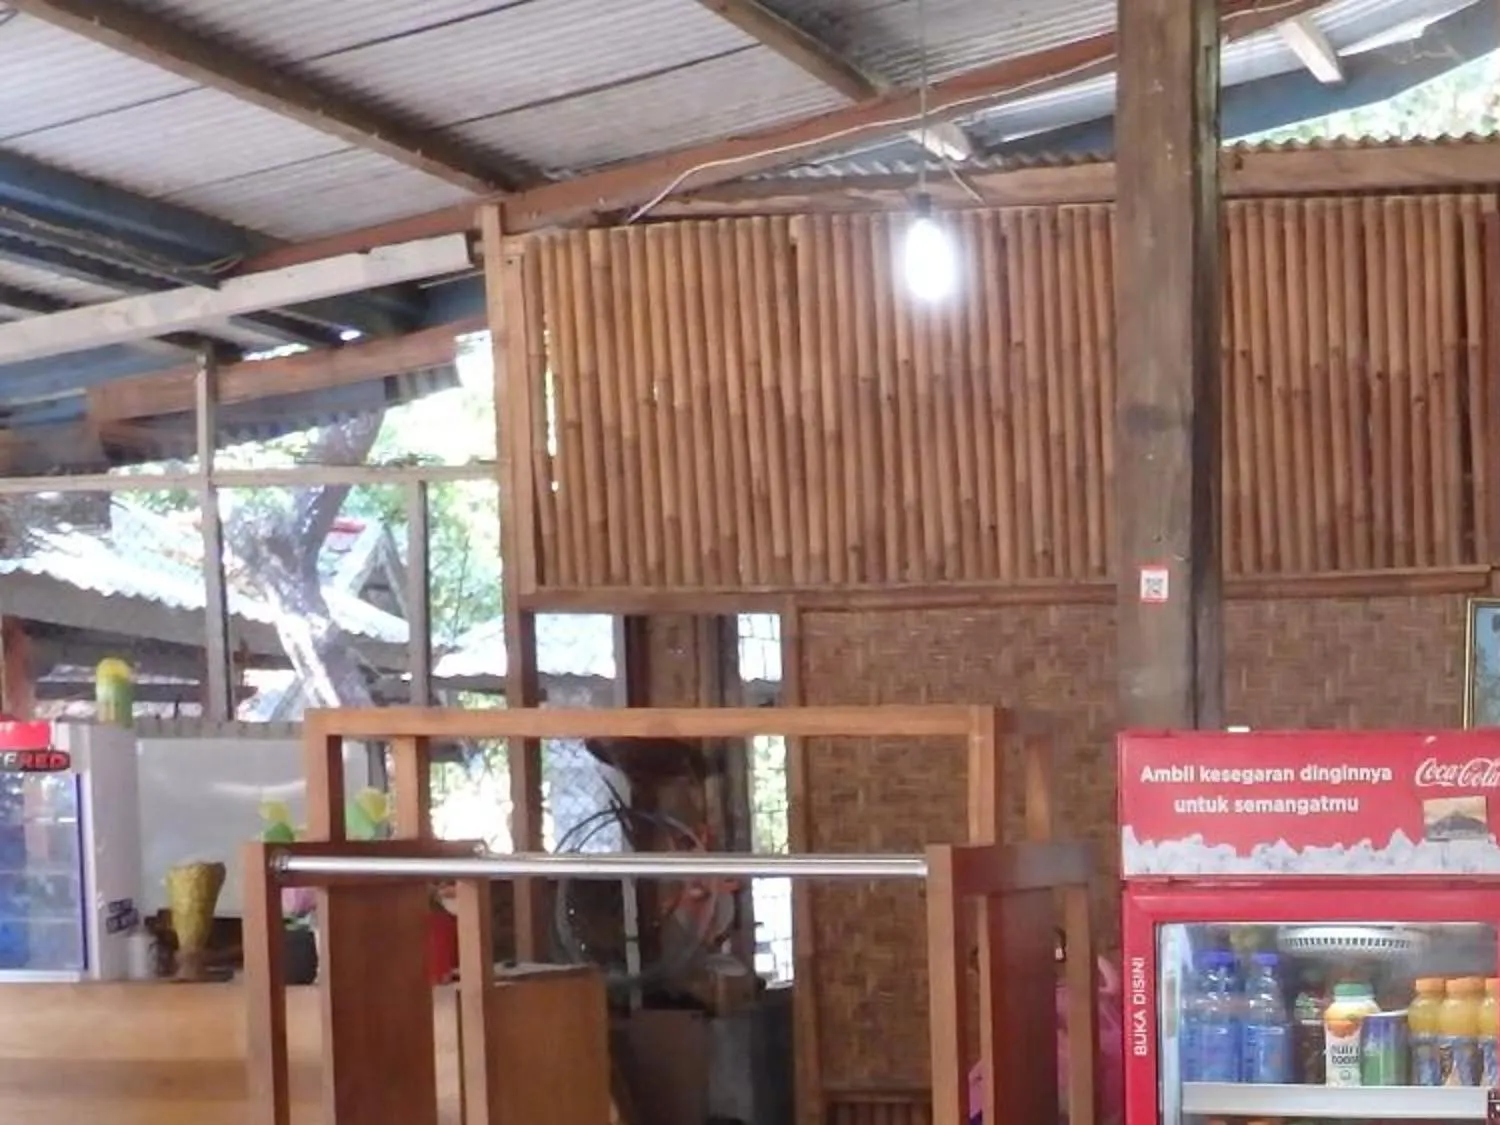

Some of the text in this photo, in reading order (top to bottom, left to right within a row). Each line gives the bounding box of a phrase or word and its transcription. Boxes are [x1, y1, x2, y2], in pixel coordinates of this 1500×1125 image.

[1140, 764, 1393, 785] Ambil kesegaran dinginnya
[1174, 795, 1360, 815] untuk semangatmu
[1132, 957, 1147, 1056] BUKA DISINI
